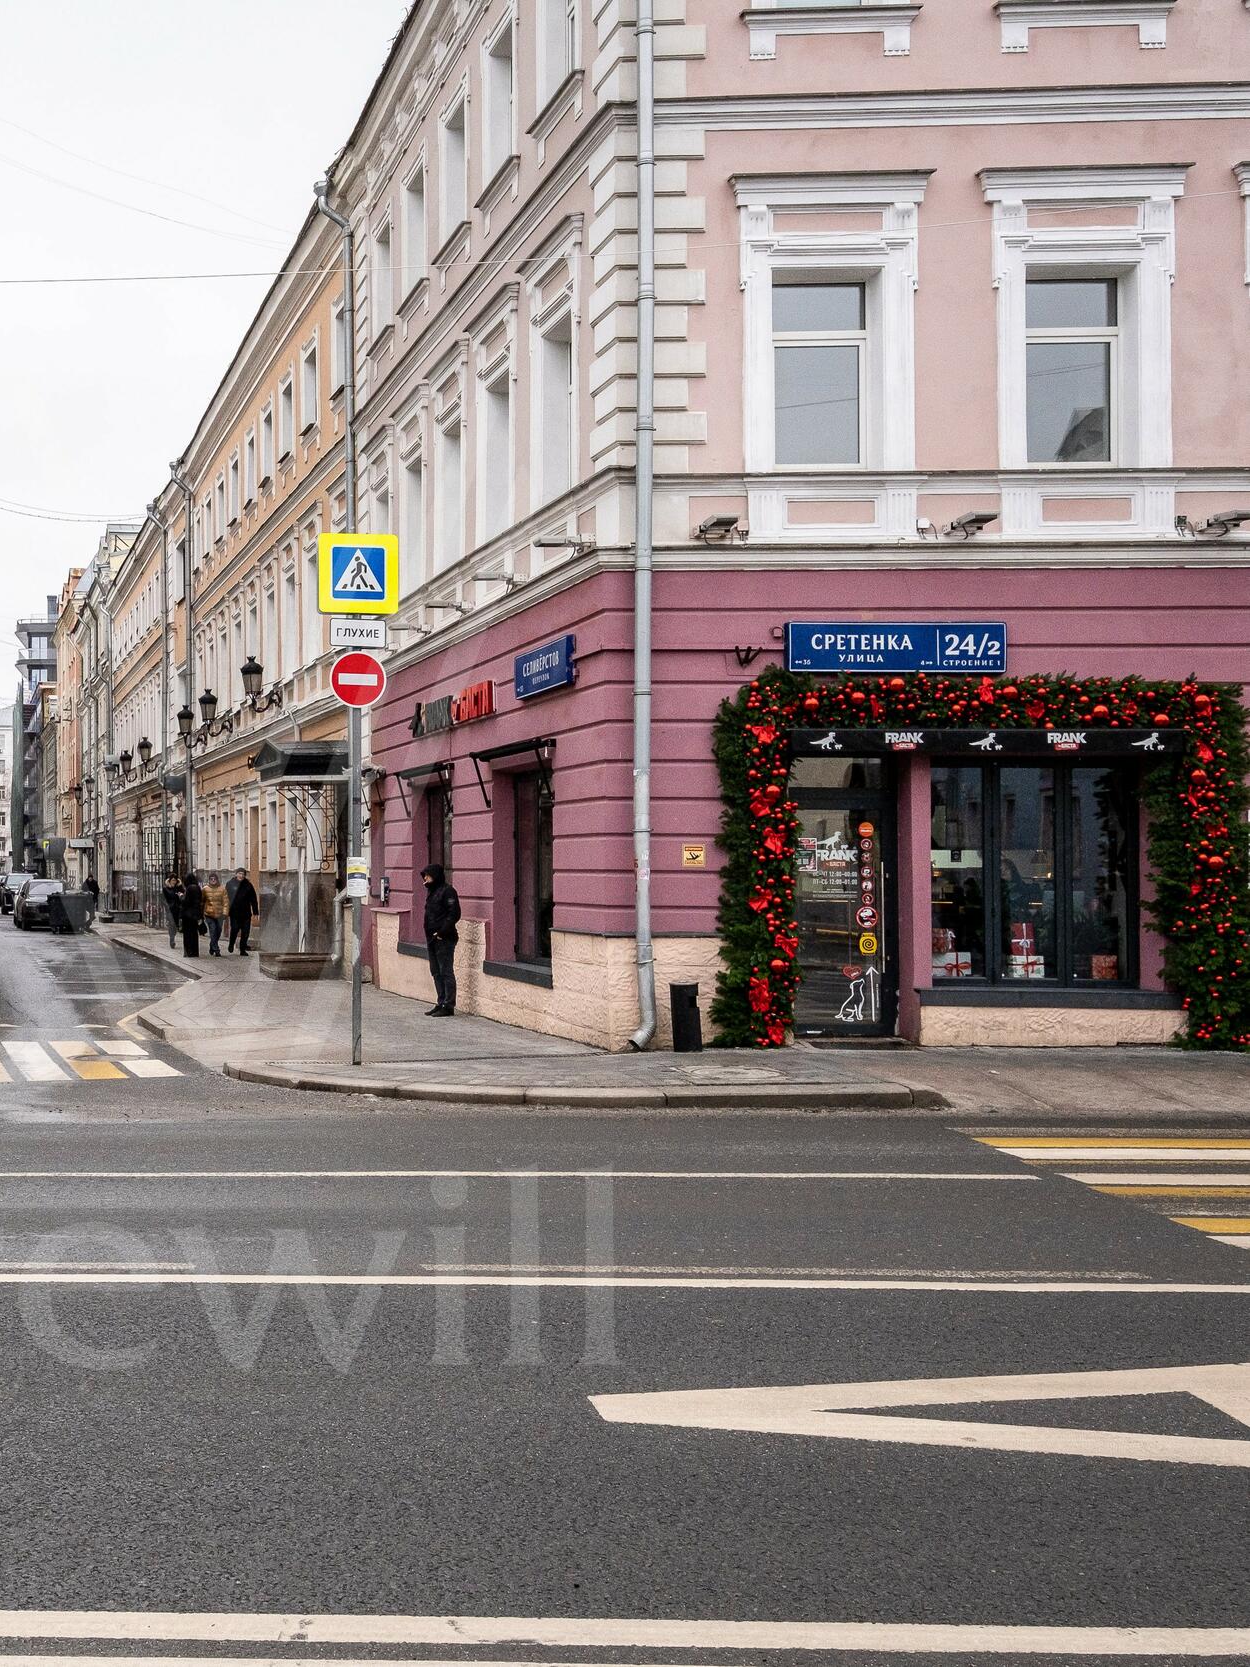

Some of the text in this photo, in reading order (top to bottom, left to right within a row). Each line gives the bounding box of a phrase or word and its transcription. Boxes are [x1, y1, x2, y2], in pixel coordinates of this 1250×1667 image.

[336, 627, 380, 639] ГЛУХИЕ
[811, 633, 1001, 658] СРЕТЕНКА 24/2
[839, 655, 884, 663] УЛИЦА
[943, 659, 994, 667] СТРОЕНИЕ
[885, 732, 924, 744] FRANK
[1047, 732, 1087, 744] FRANK
